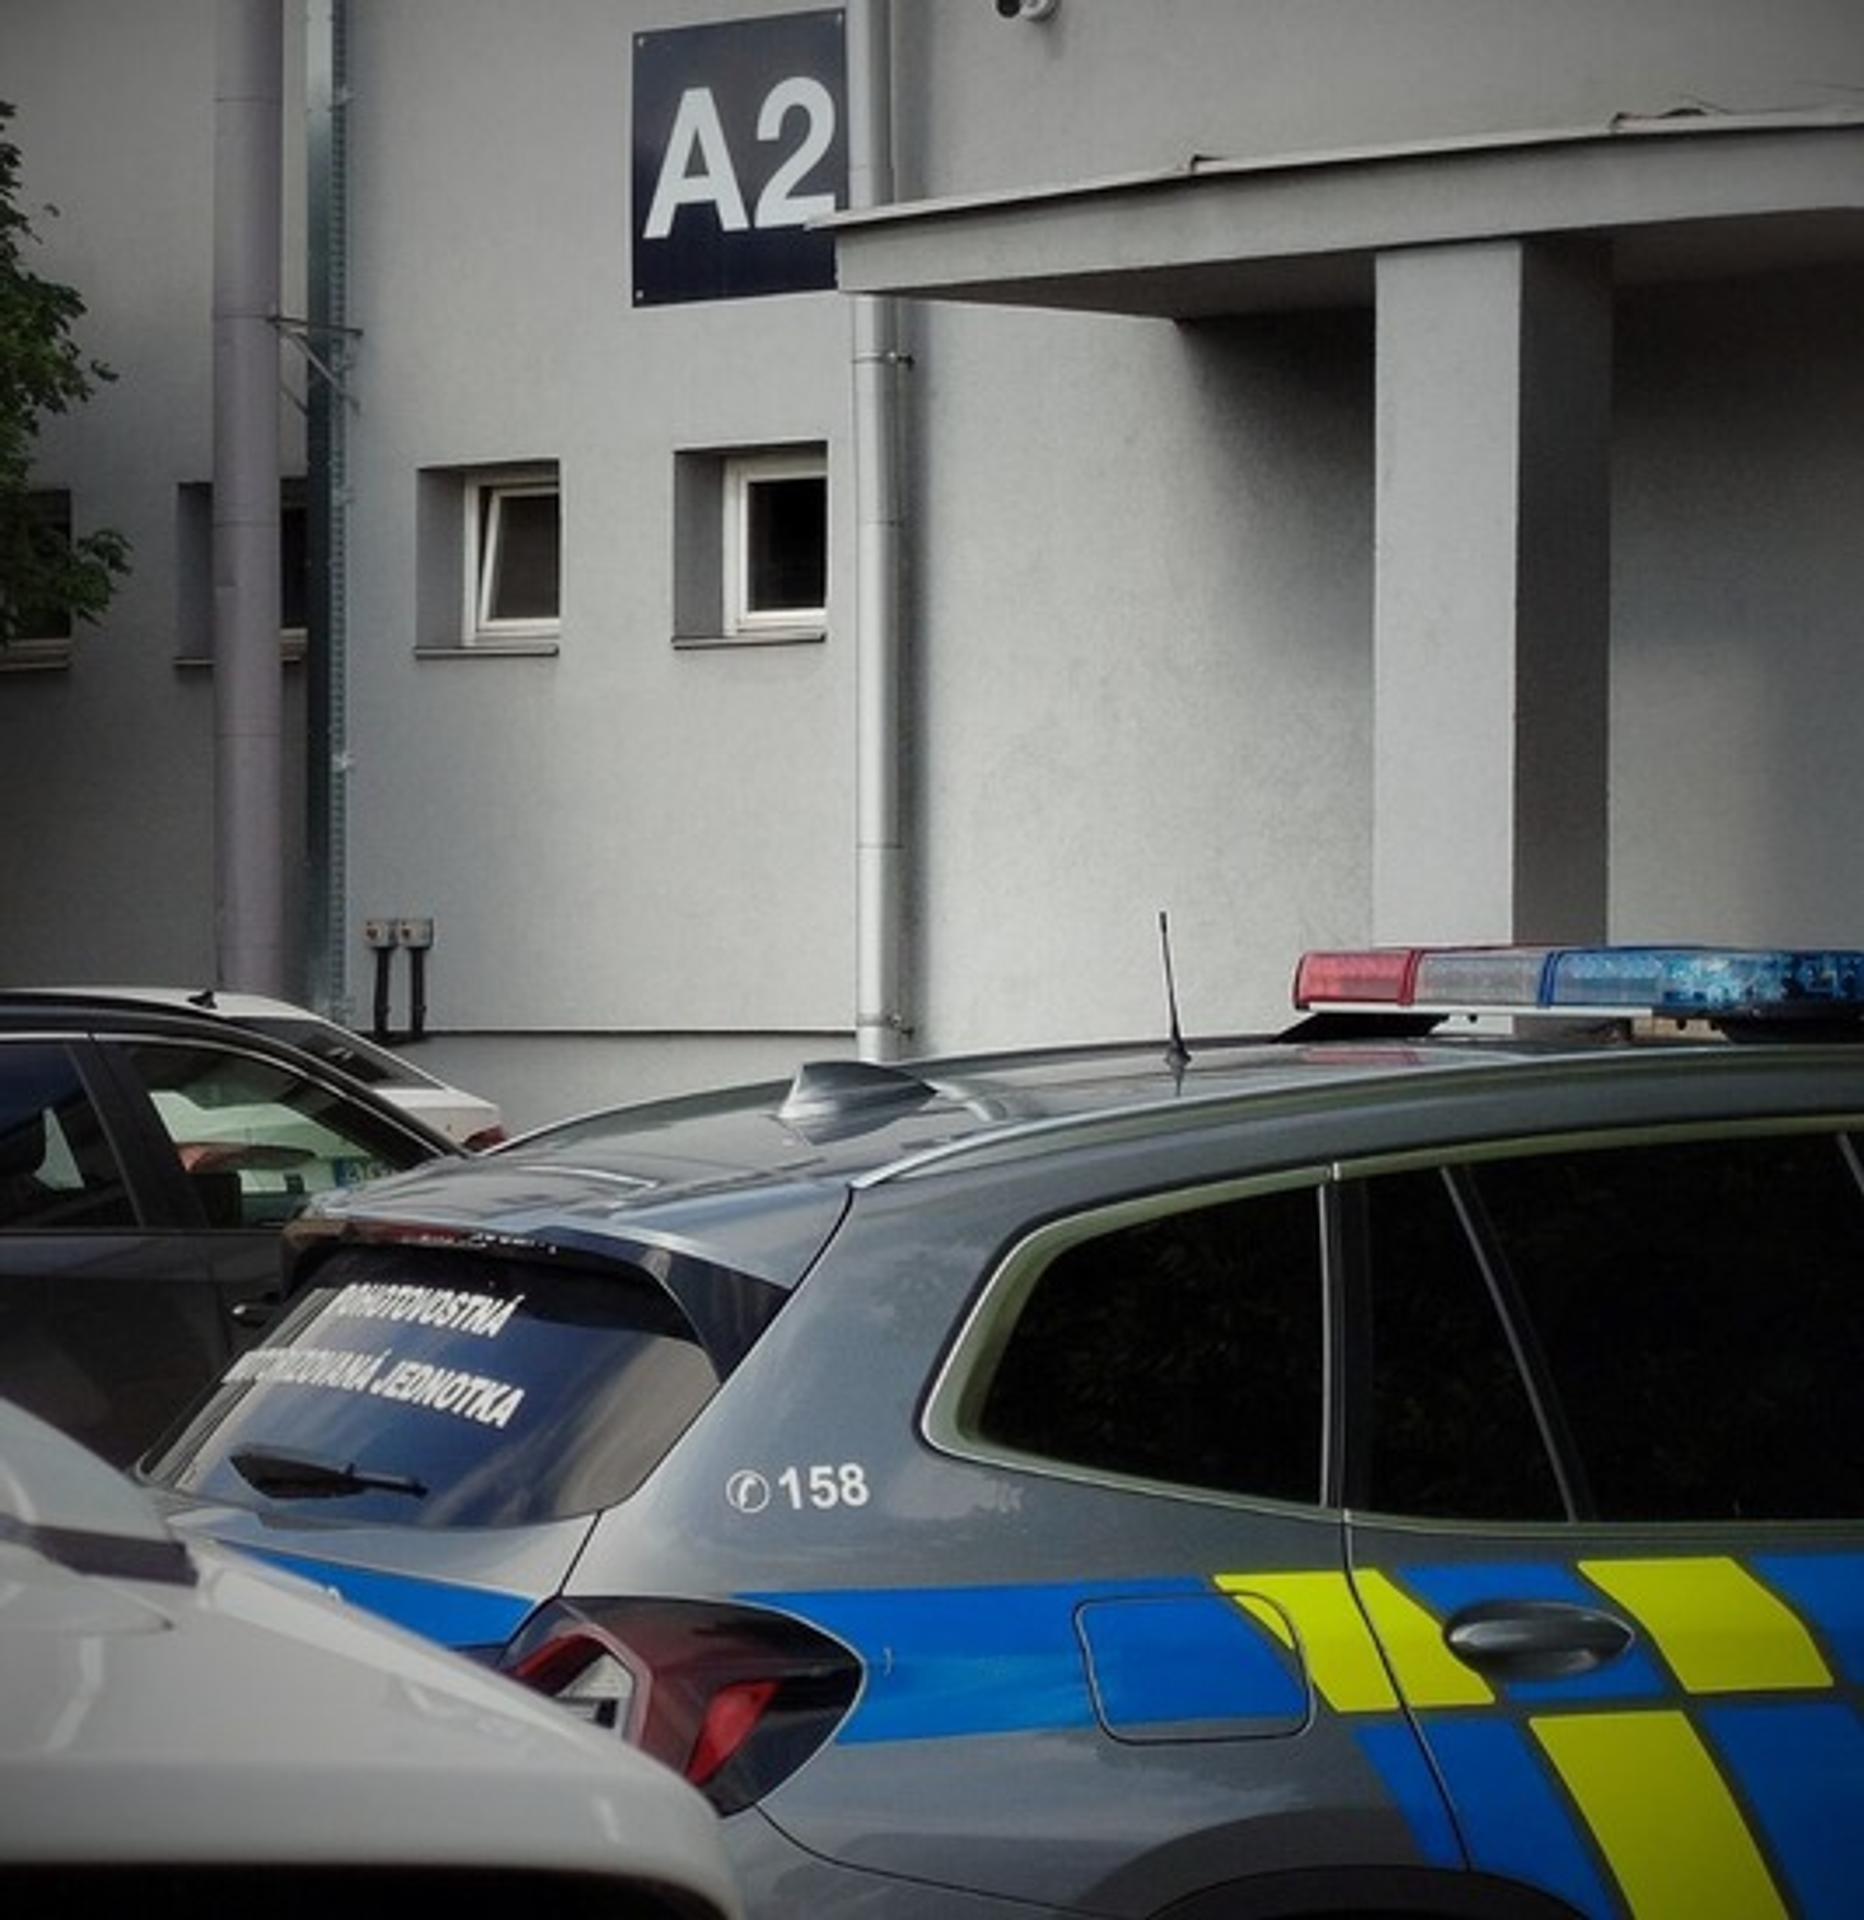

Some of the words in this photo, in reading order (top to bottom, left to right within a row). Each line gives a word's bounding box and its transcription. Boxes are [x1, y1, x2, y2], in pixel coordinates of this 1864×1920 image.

[643, 76, 836, 239] A2
[370, 1361, 525, 1428] JEDNOTKA
[778, 1463, 869, 1509] 158
